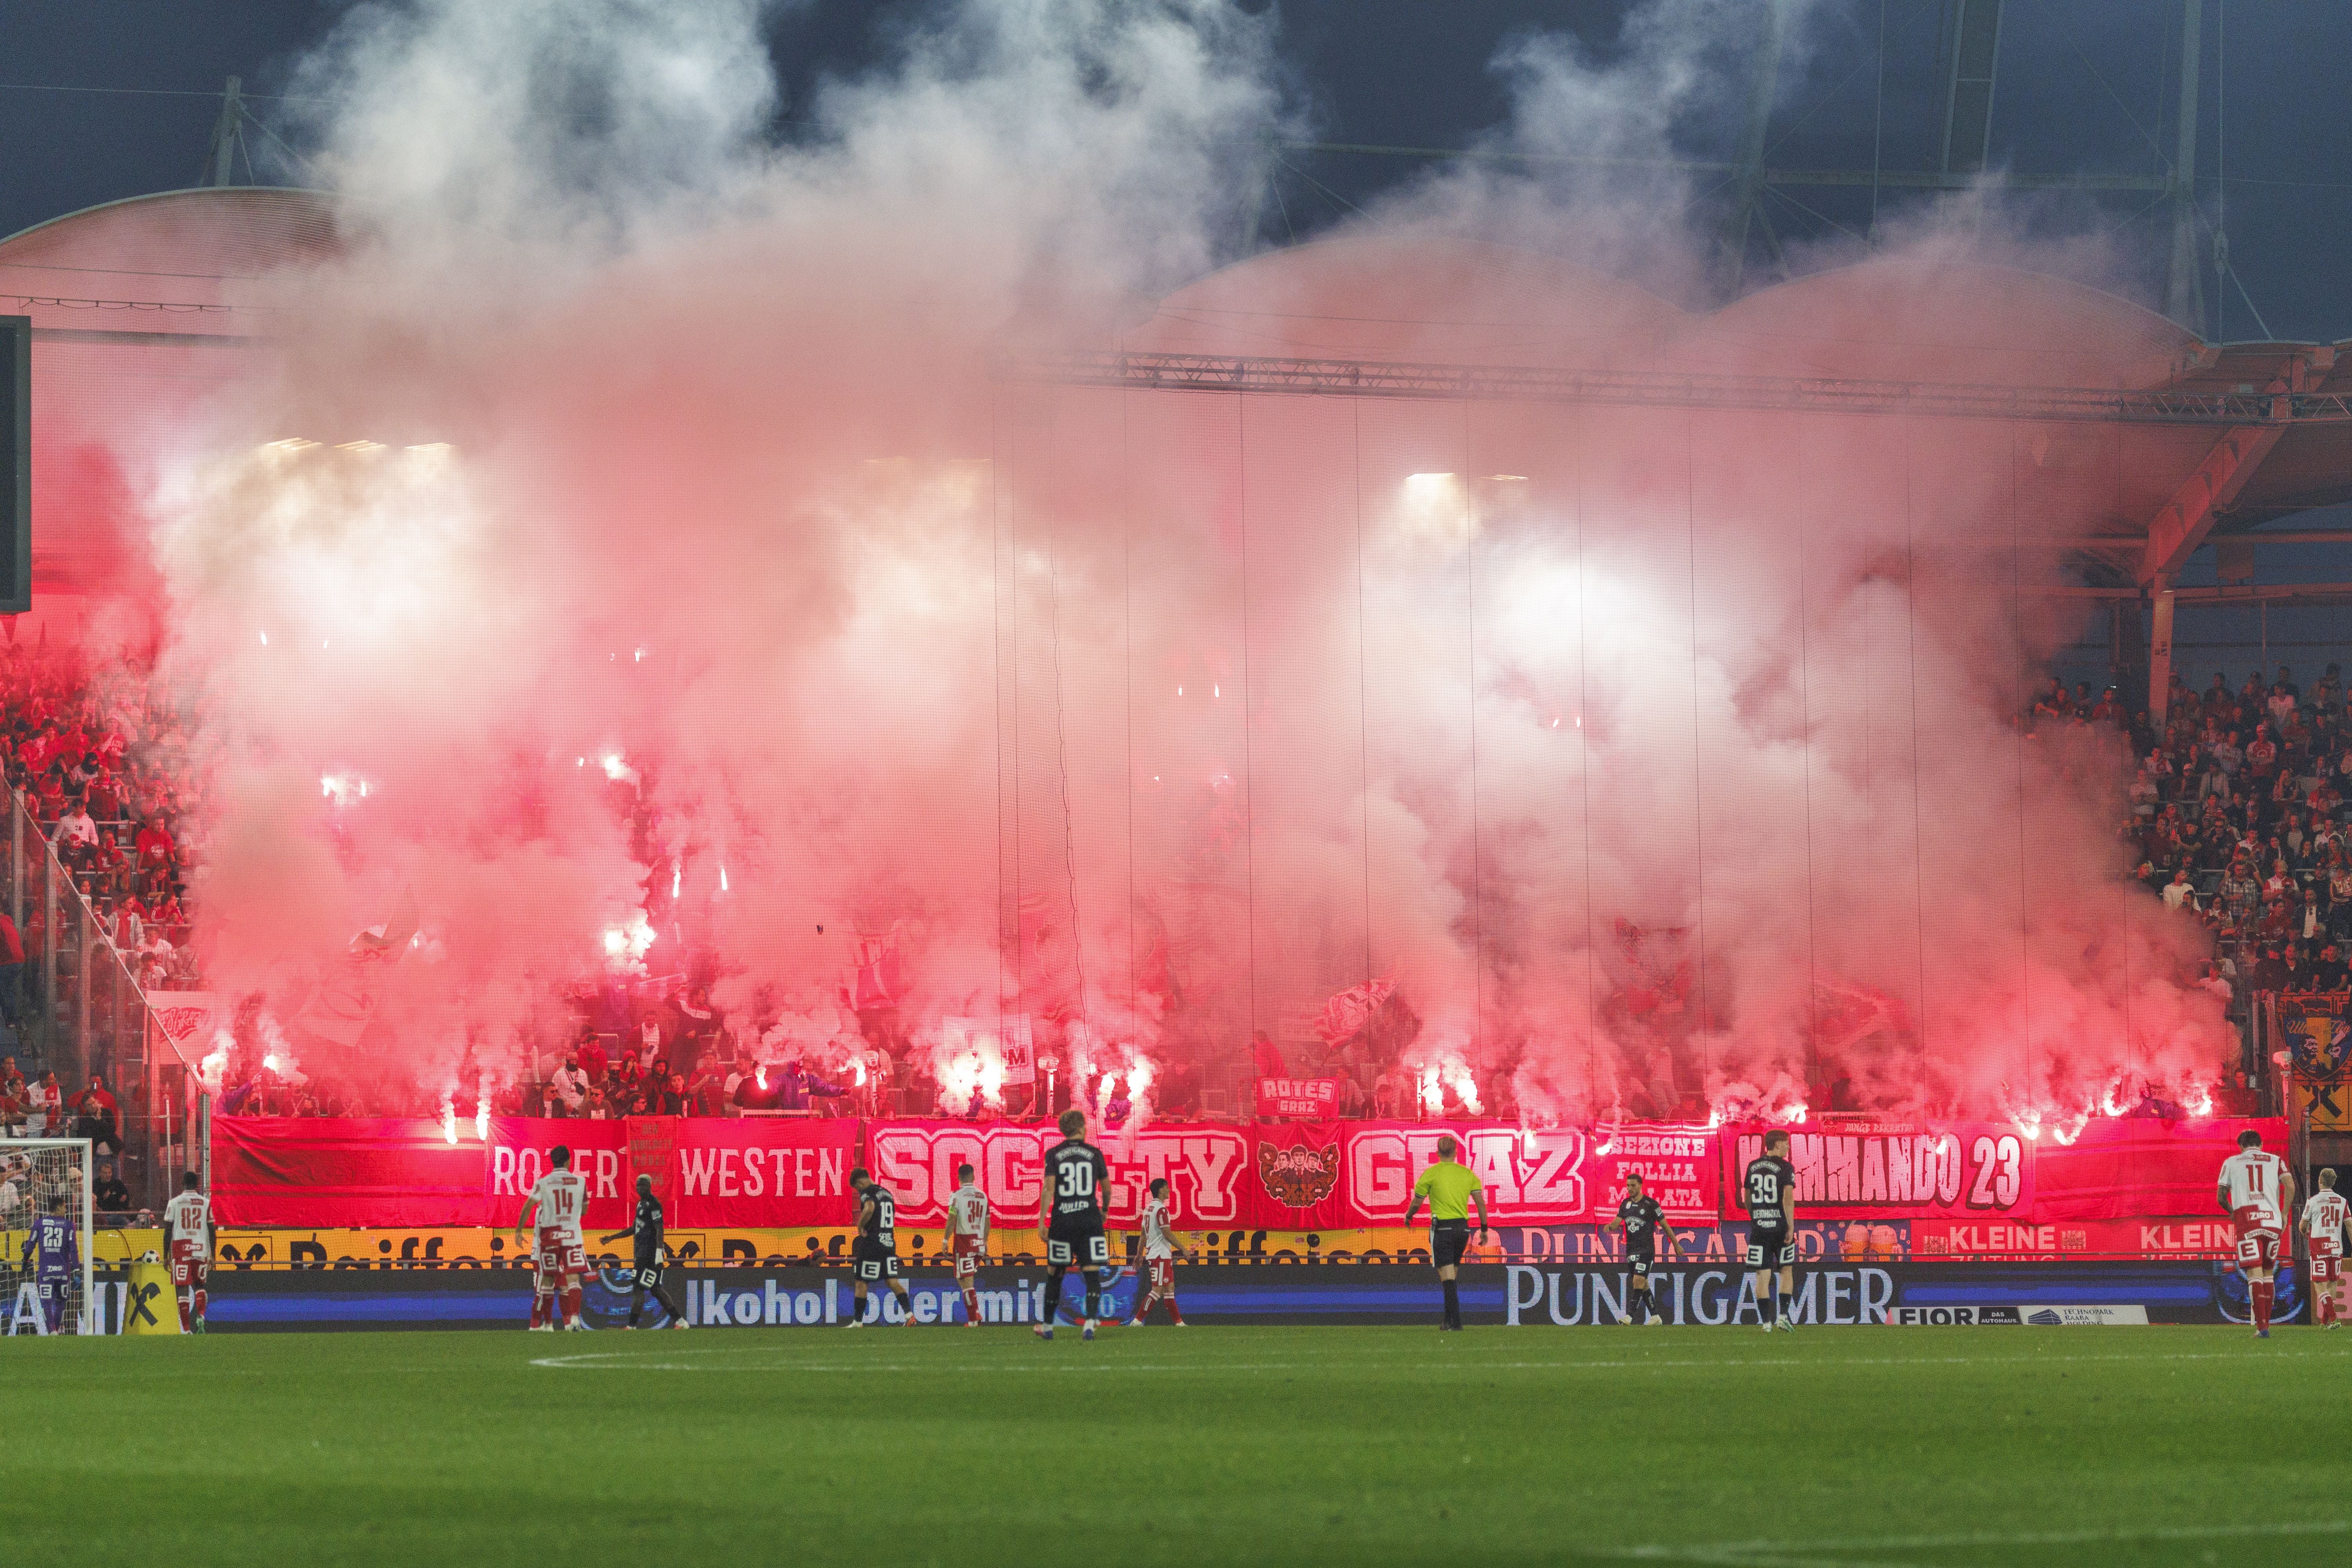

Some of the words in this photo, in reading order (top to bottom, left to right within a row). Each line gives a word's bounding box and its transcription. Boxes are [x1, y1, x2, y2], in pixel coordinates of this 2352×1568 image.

[1262, 1078, 1335, 1102] ROTES
[1278, 1099, 1318, 1114] GRAZ
[1845, 1123, 1871, 1134] JUNGE
[1612, 1136, 1705, 1157] SEZIONE
[493, 1145, 619, 1198] ROER
[679, 1147, 844, 1197] WESTEN
[876, 1129, 1246, 1219] SOCETY
[1617, 1162, 1697, 1181] FOLLIA
[1739, 1133, 1961, 1204] KMMANDO
[1969, 1135, 2022, 1207] 23
[1751, 1161, 1779, 1171] PUNTIGAMER
[1059, 1161, 1093, 1196] 30
[1751, 1174, 1778, 1203] 39
[2245, 1164, 2263, 1192] 11
[553, 1189, 573, 1215] 14
[1608, 1186, 1703, 1207] MLATA
[181, 1207, 202, 1229] 82
[880, 1201, 894, 1229] 19
[967, 1200, 983, 1223] 34
[2250, 1211, 2271, 1220] ZIRO
[2321, 1205, 2340, 1227] 24
[44, 1227, 64, 1247] 23
[1950, 1226, 2055, 1250] KLEINE
[2141, 1225, 2237, 1249] KLEIN
[1899, 1308, 1973, 1325] FIOR
